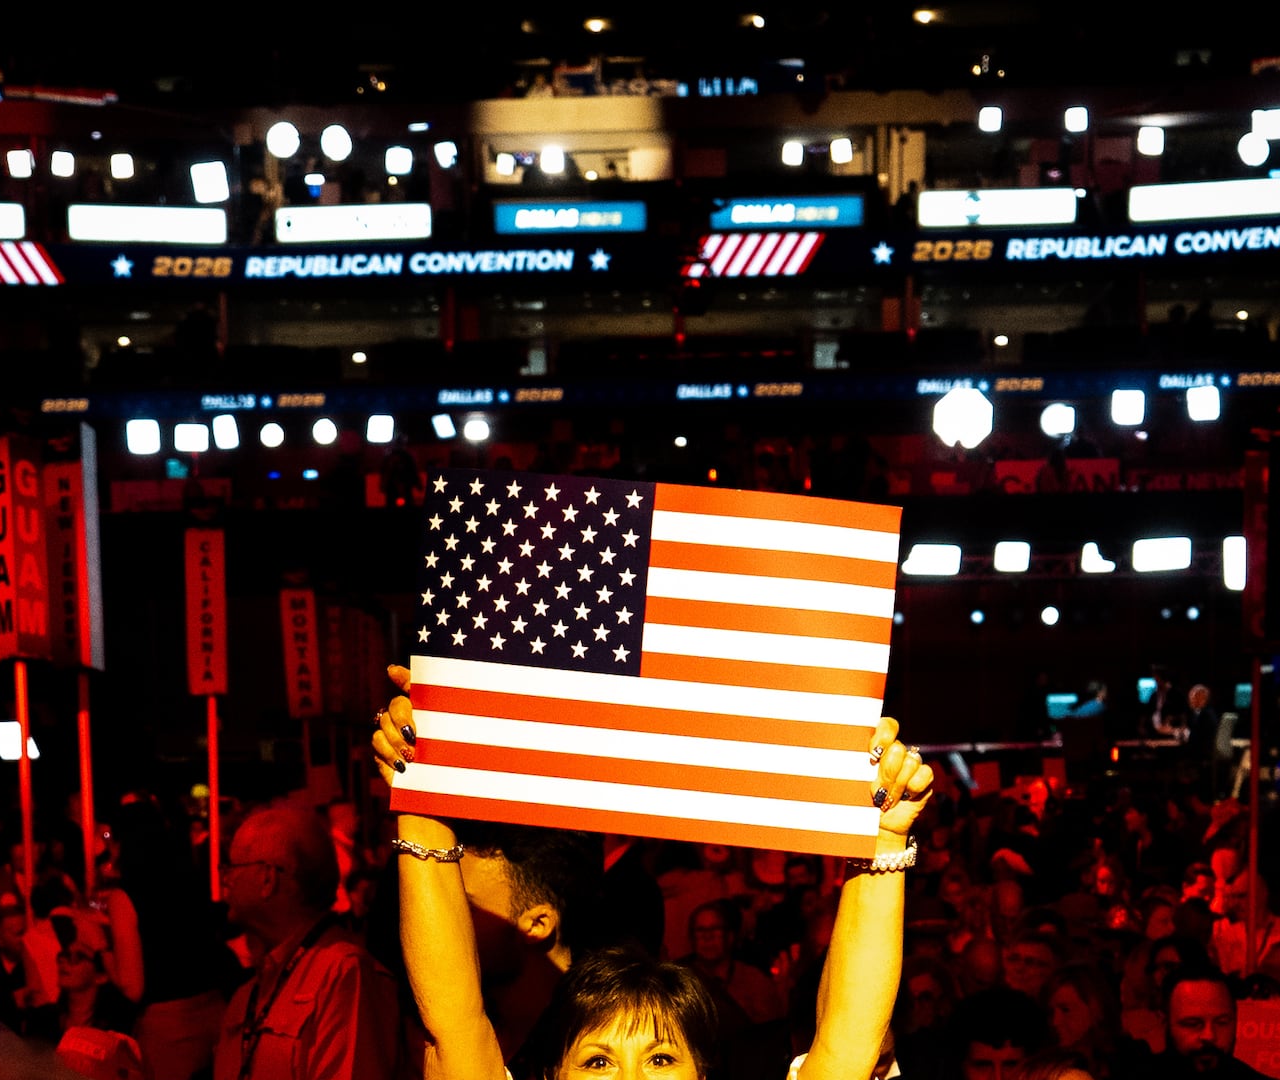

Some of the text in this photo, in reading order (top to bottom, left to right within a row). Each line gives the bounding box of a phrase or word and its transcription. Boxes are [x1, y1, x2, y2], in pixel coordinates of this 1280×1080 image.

[151, 248, 574, 278] 2026 REPUBLICAN CONVENTION
[912, 239, 993, 261] 2026
[1006, 233, 1167, 261] REPUBLICAN
[15, 458, 47, 637] GUAM
[198, 540, 215, 682] CALIFORNIA
[288, 596, 314, 709] MONTANA
